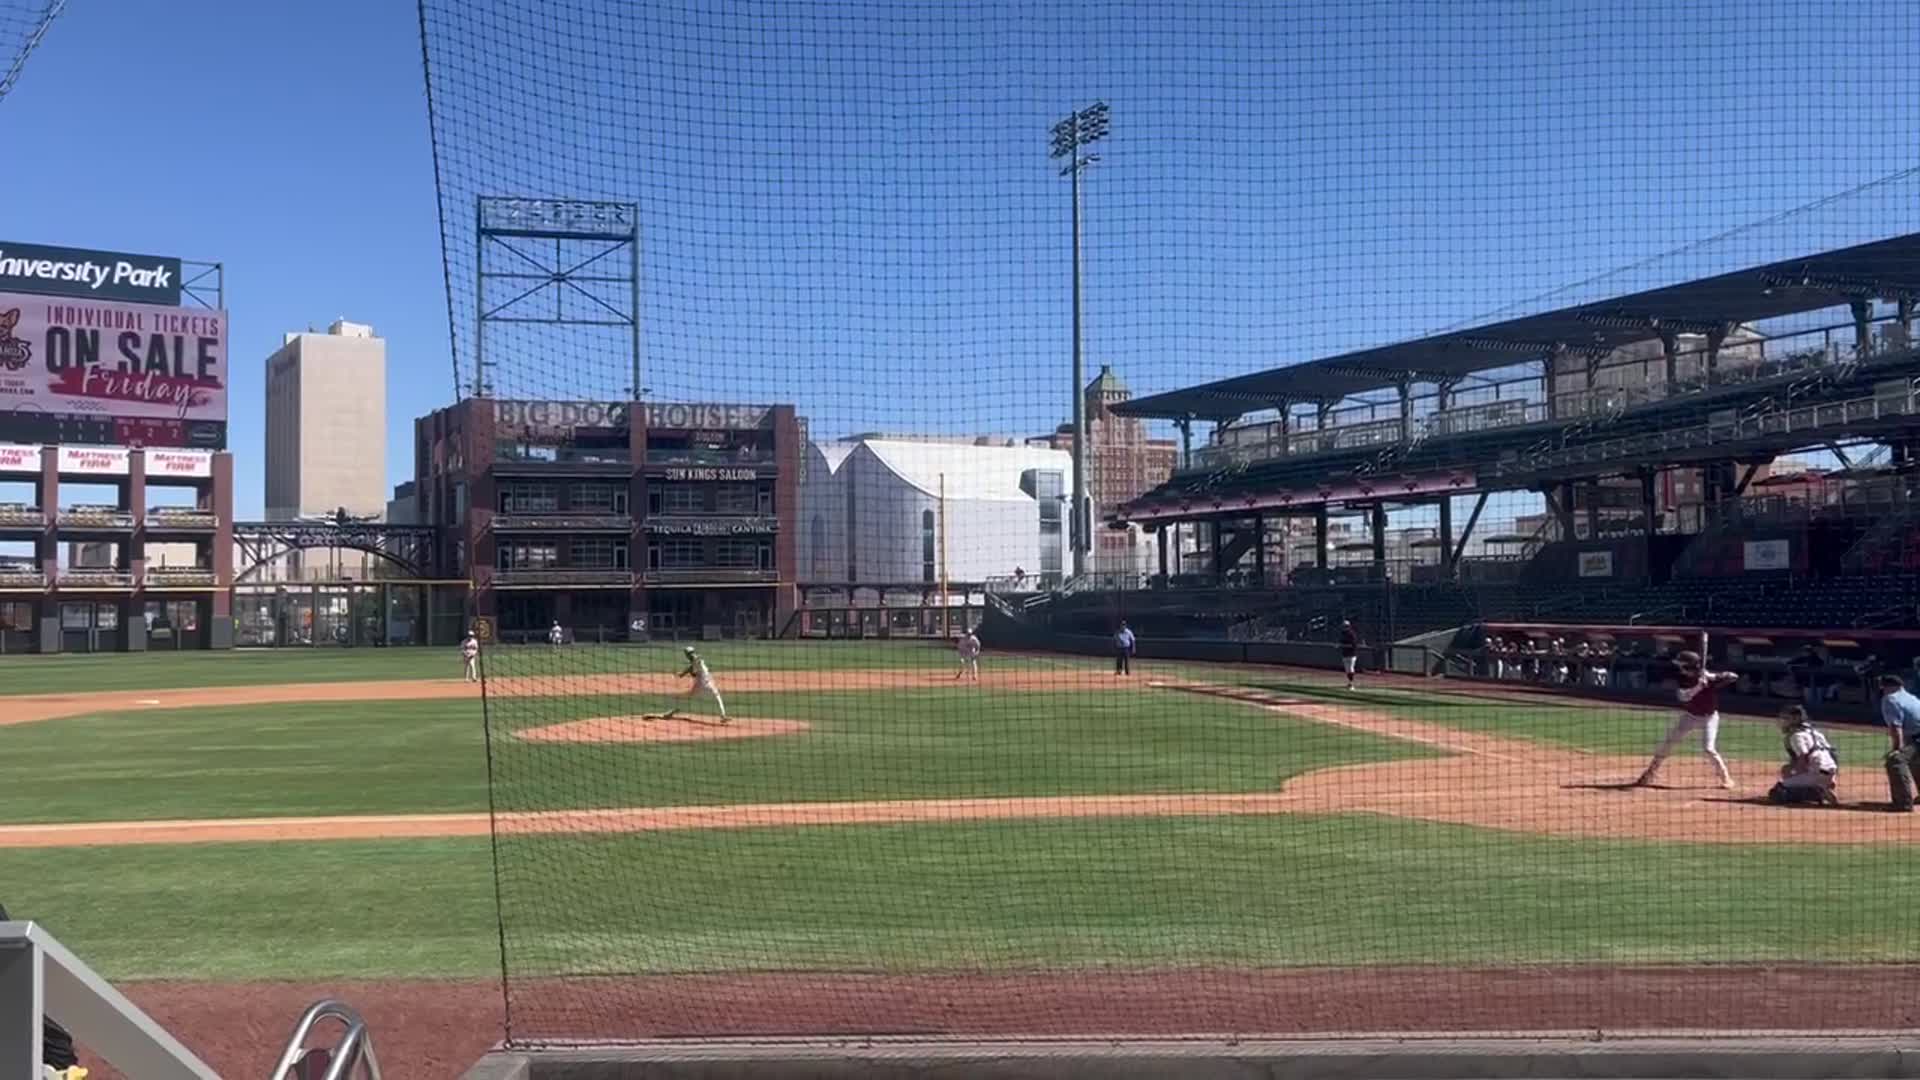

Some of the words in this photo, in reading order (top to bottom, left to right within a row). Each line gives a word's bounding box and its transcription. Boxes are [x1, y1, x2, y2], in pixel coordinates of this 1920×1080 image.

[0, 252, 110, 289] niversity
[113, 261, 172, 288] Park
[47, 305, 144, 331] INDIVIDUAL
[153, 313, 219, 336] TICKETS
[46, 326, 100, 376] ON
[116, 331, 219, 384] SALE
[82, 361, 193, 421] Friday
[665, 468, 686, 480] SUN
[687, 468, 717, 480] KINGS
[719, 469, 757, 480] SALOON
[631, 619, 645, 631] 42
